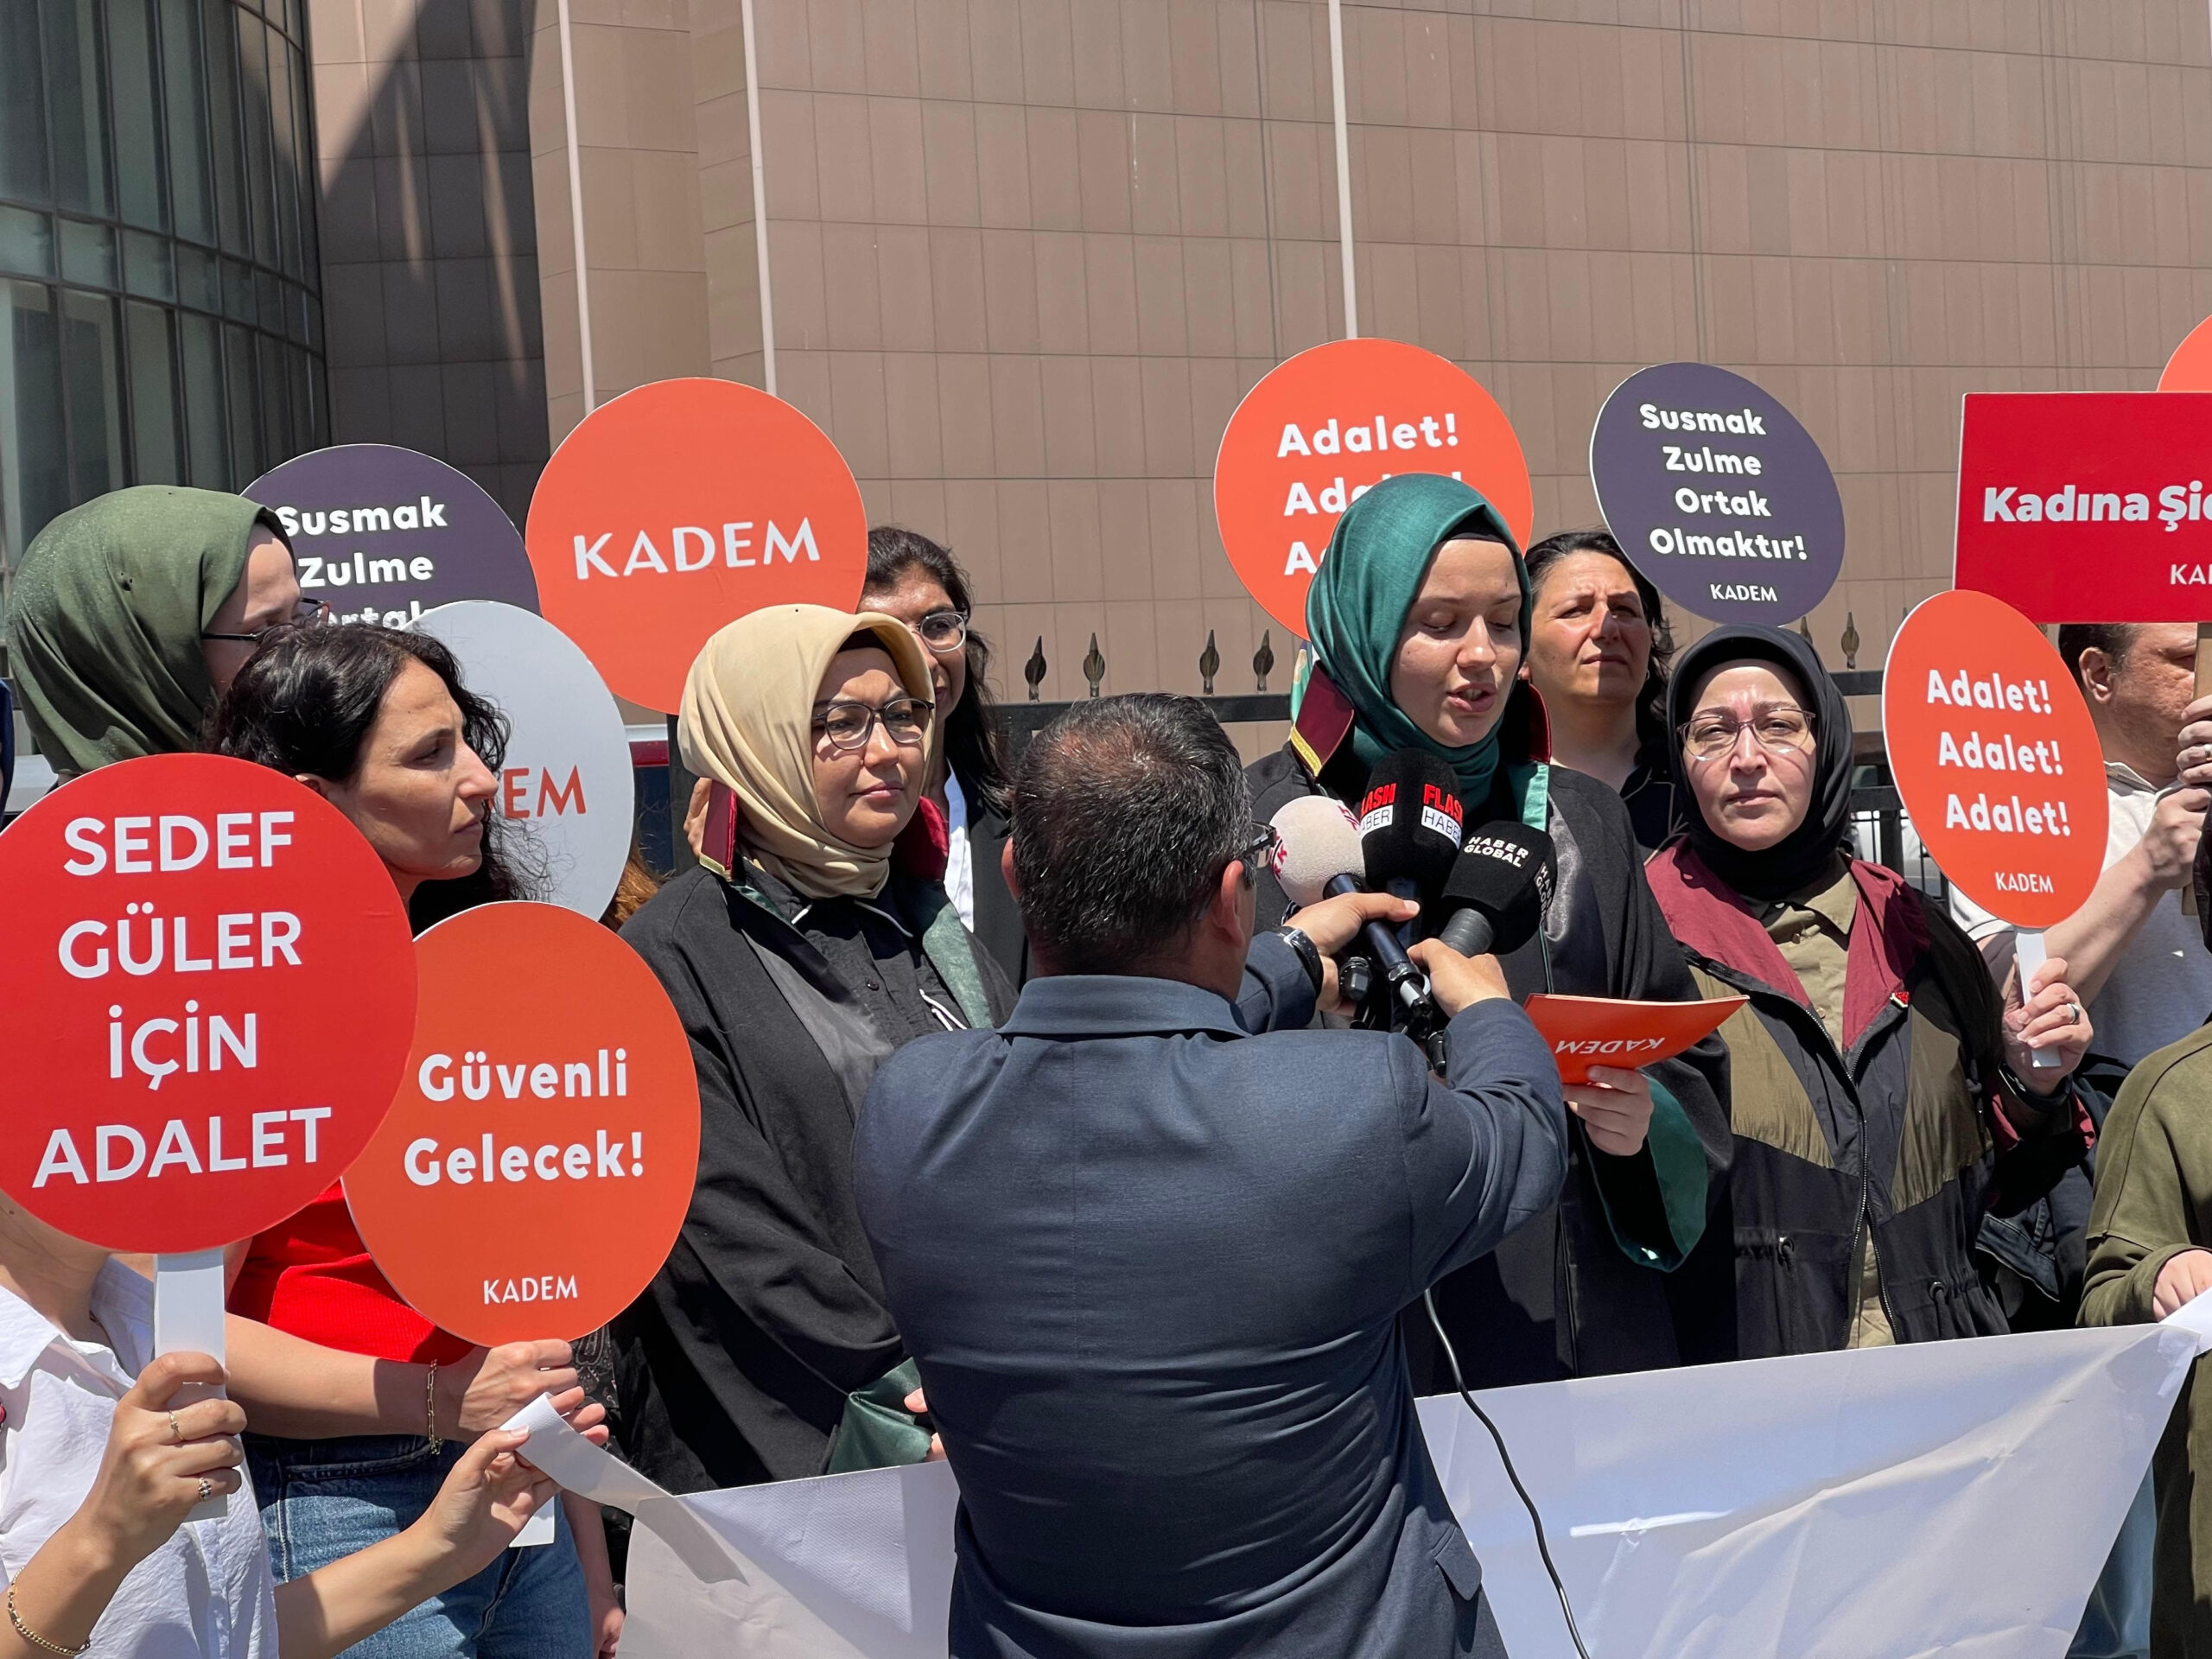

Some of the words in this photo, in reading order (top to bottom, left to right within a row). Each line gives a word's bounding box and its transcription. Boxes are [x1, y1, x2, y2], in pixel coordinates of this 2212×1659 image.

[1277, 413, 1459, 458] Adalet!
[1639, 404, 1767, 435] Susmak
[1662, 446, 1762, 476] Zulme
[274, 496, 448, 537] Susmak
[1675, 487, 1771, 517] Ortak
[1983, 484, 2150, 523] Kadına
[573, 517, 820, 580] KADEM
[1649, 528, 1808, 561] Olmaktır!
[297, 552, 434, 588] Zulme
[1710, 583, 1778, 602] KADEM
[1927, 669, 2052, 715] Adalet!
[1938, 731, 2063, 775] Adalet!
[1361, 783, 1397, 820] LASH
[1423, 783, 1463, 828] FLAS
[1946, 792, 2071, 837] Adalet!
[63, 810, 295, 876] SEDEF
[1424, 810, 1460, 843] HABE
[1464, 844, 1522, 868] GLOBAL
[1468, 836, 1529, 859] HABER
[1994, 872, 2054, 893] KADEM
[58, 901, 302, 979] GÜLER
[108, 999, 257, 1091] İÇİN
[1554, 1037, 1665, 1054] KADEM
[418, 1047, 627, 1102] Güvenli
[31, 1106, 332, 1188] ADALET
[404, 1129, 644, 1186] Gelecek!
[483, 1274, 578, 1305] KADEM
